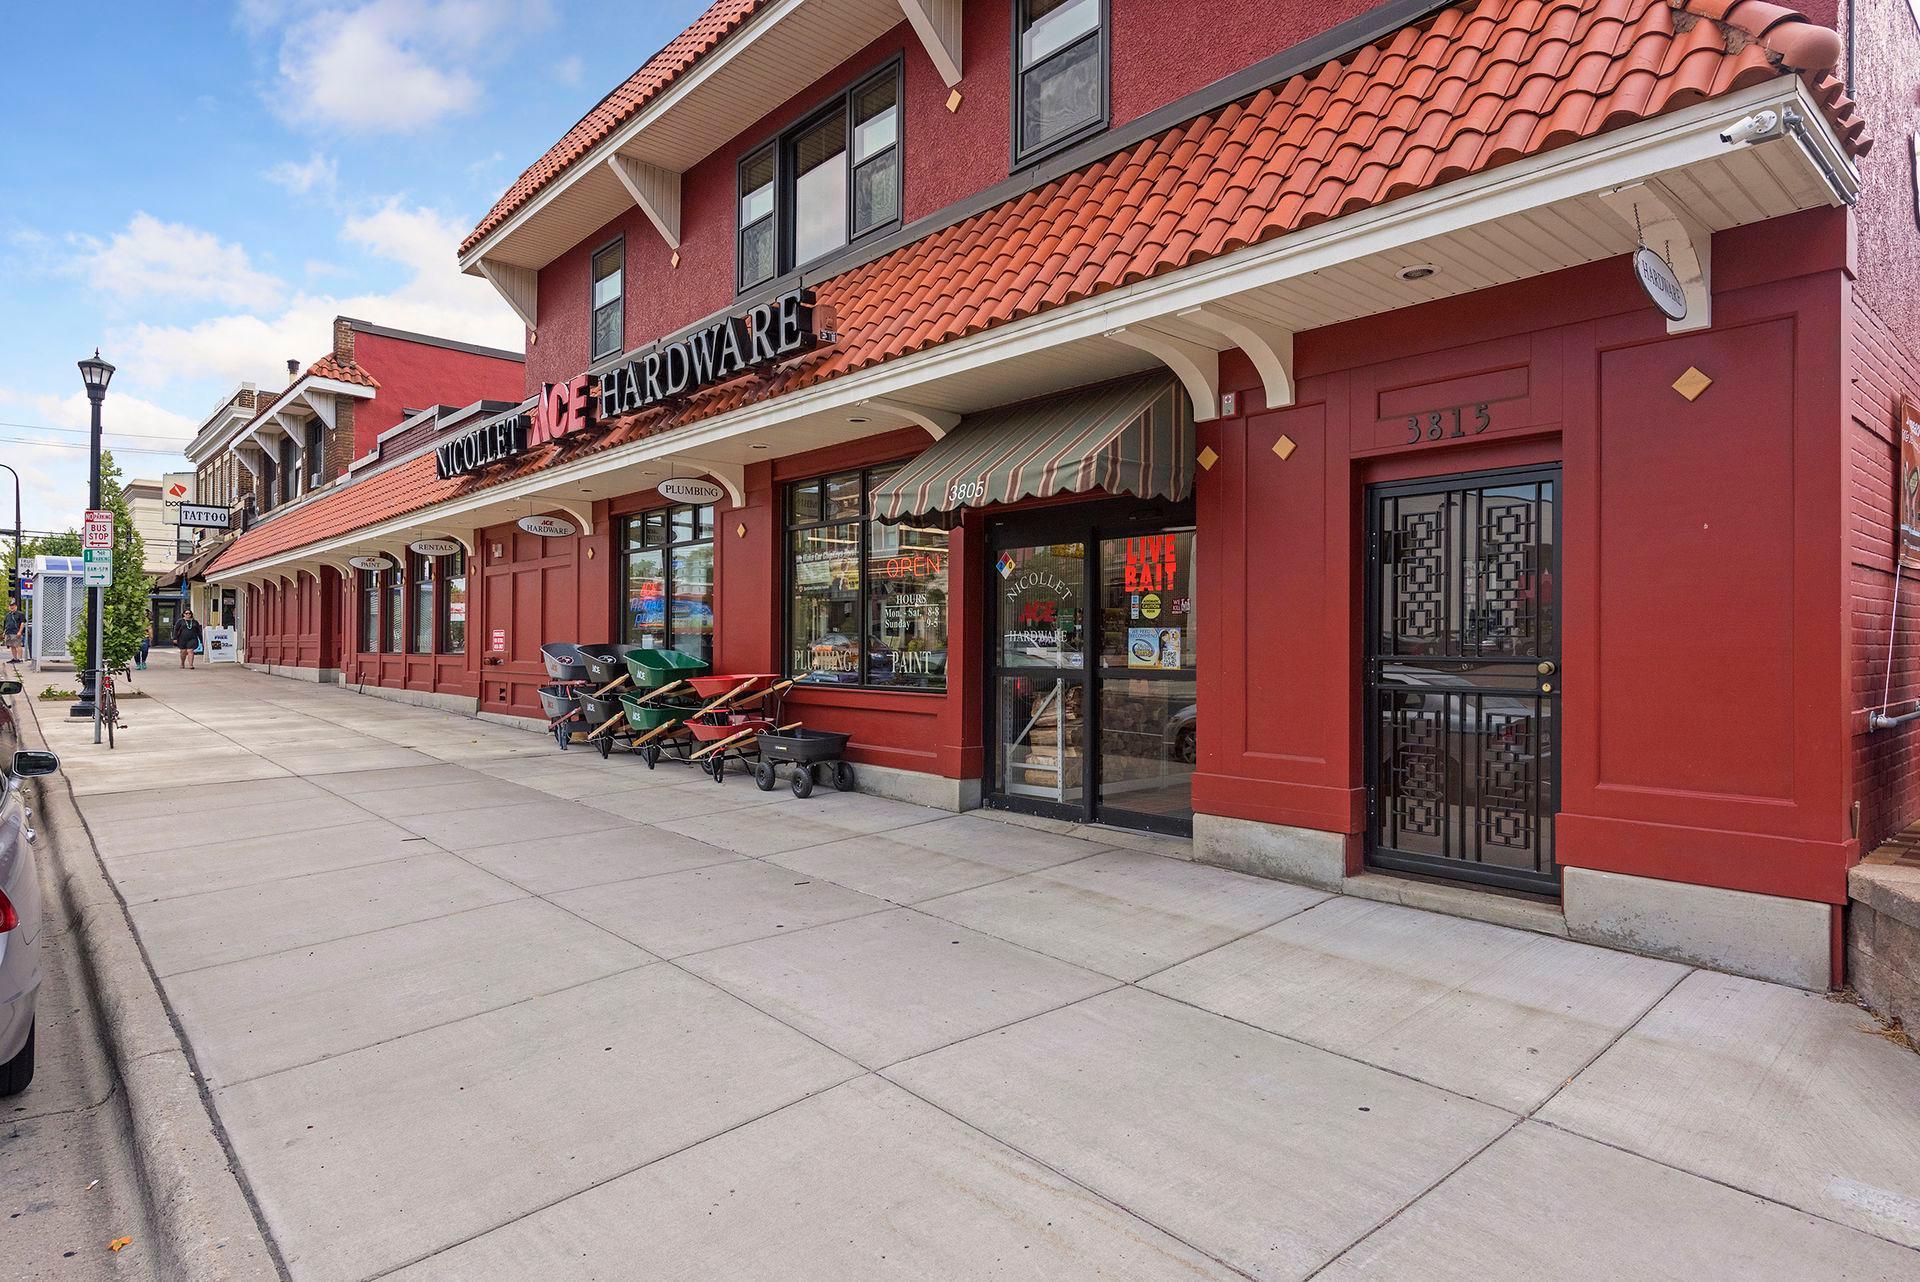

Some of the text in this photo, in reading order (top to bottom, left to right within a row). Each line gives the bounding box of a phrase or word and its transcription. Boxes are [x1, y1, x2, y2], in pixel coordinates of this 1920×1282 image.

[436, 286, 804, 481] NICOLLET ACE HARDWARE
[1407, 401, 1491, 445] 3815
[665, 484, 719, 498] PLUMBING
[948, 480, 985, 502] 3805
[182, 510, 227, 523] TATTOO
[91, 524, 107, 532] BUS
[526, 524, 569, 535] HARDWARE
[88, 532, 109, 541] STOP
[418, 543, 454, 552] RENTALS
[1126, 533, 1176, 565] LIVE
[886, 554, 941, 578] OPEN
[1006, 571, 1073, 603] NICOLLET
[896, 594, 927, 605] HOURS
[885, 608, 902, 618] Mon.
[908, 607, 922, 617] Sat.
[928, 606, 940, 617] 8-8
[1018, 599, 1058, 623] ACE
[885, 618, 939, 631] Sunday 9-5
[1008, 630, 1069, 643] HARDWARE
[794, 650, 852, 672] PLUMBING
[892, 651, 932, 674] PAINT
